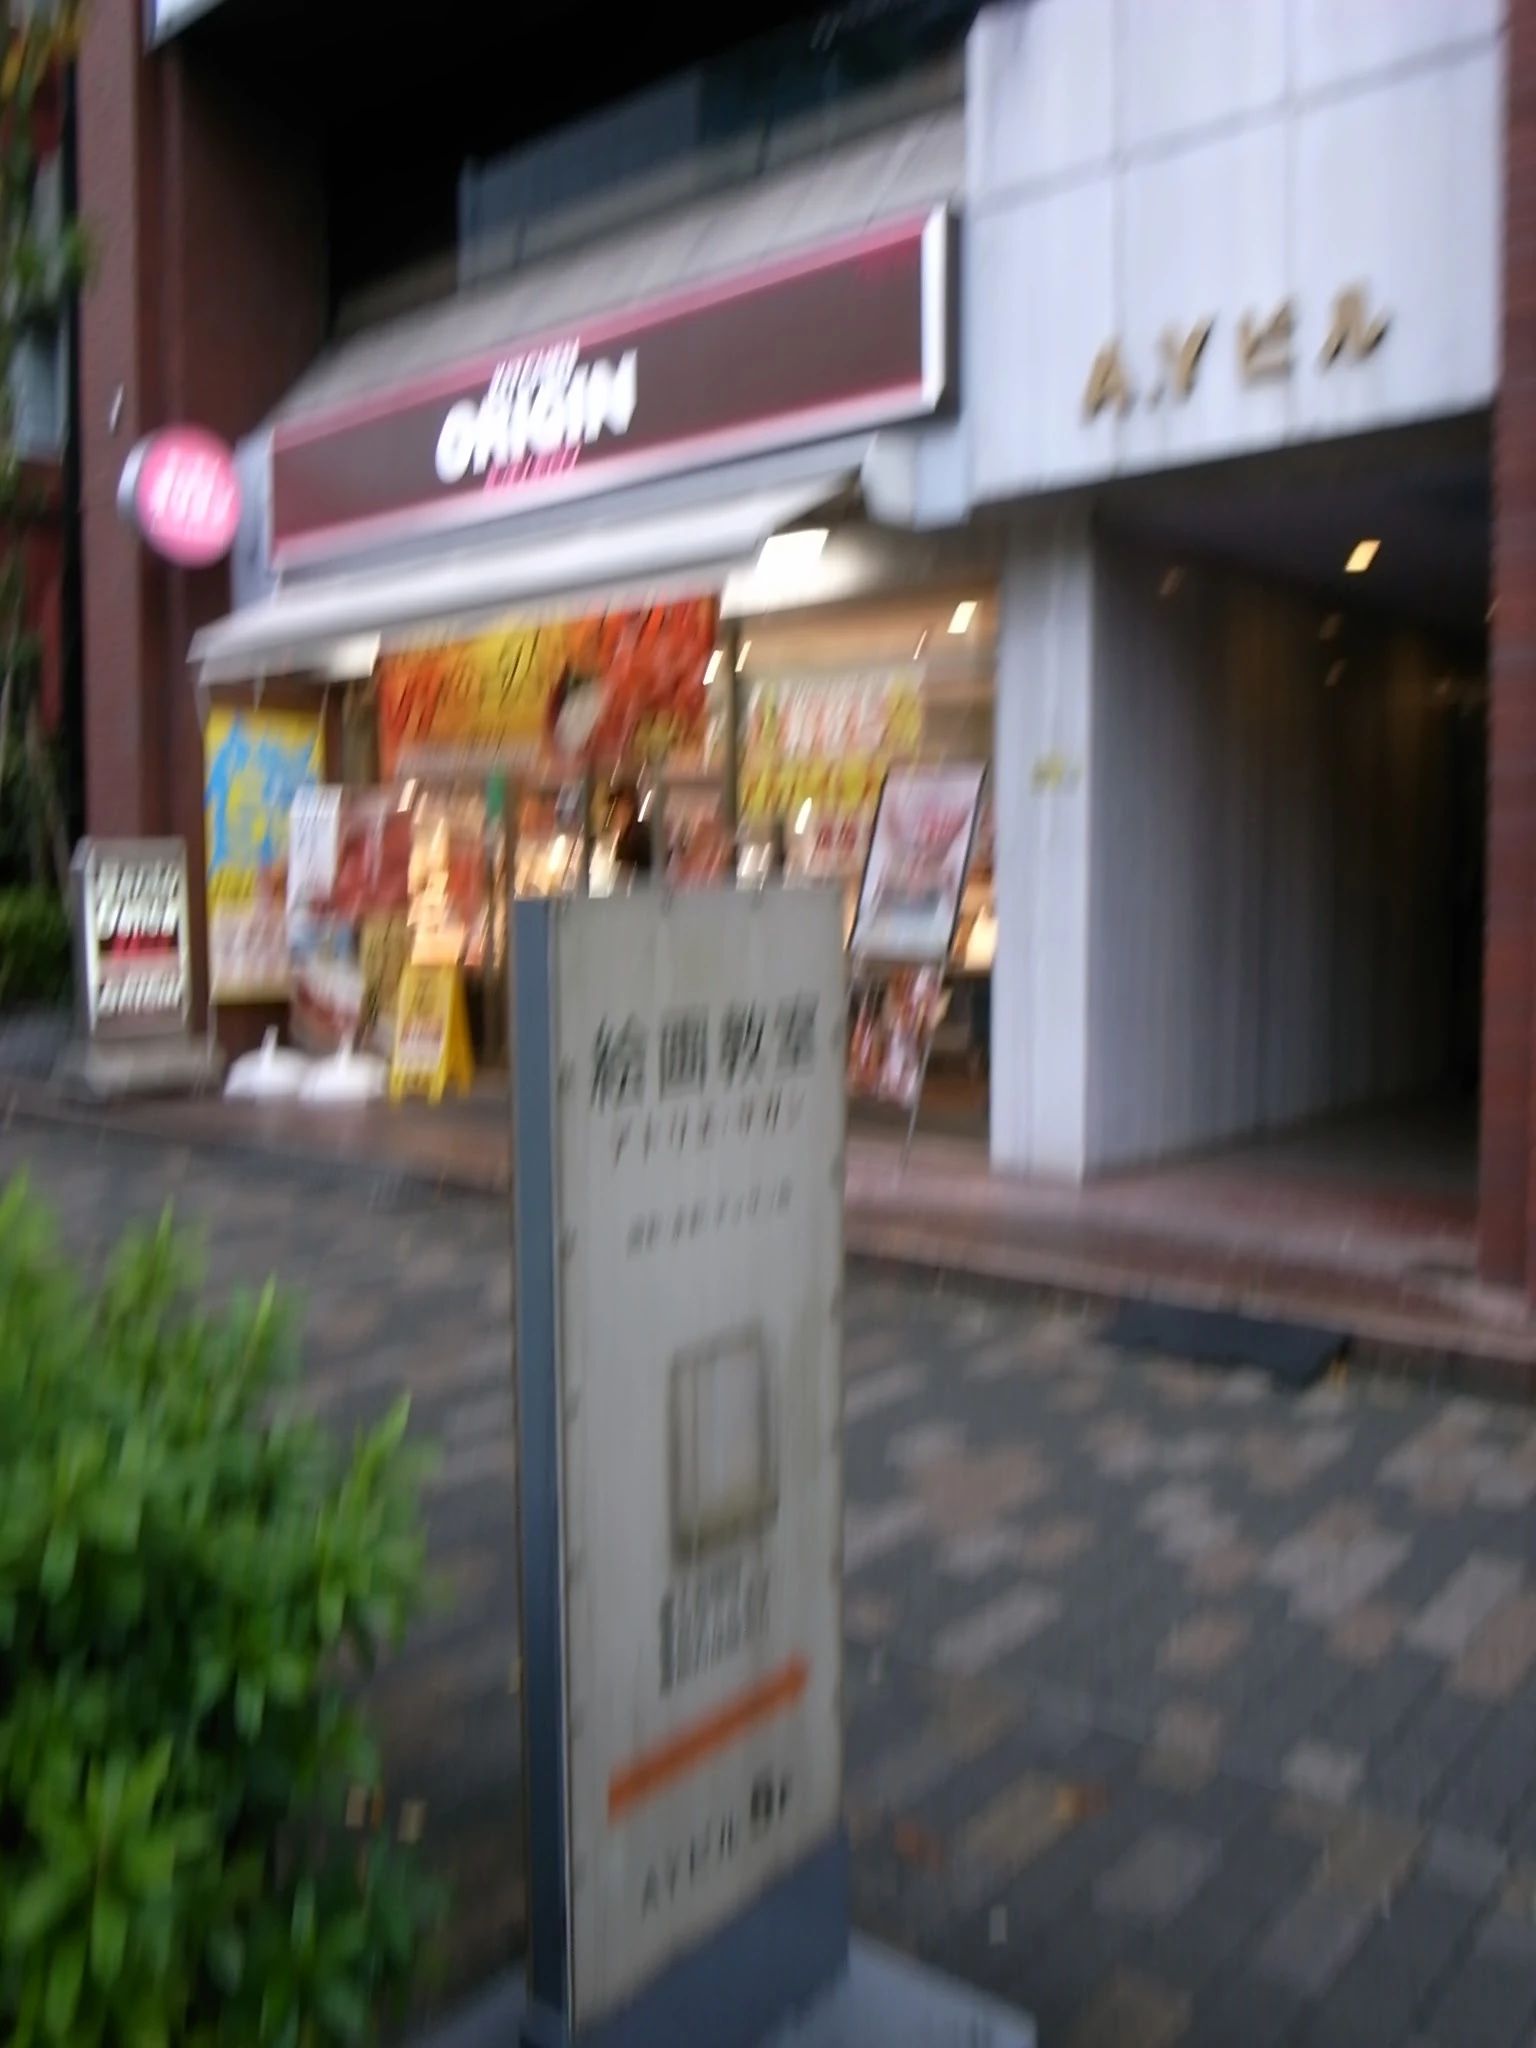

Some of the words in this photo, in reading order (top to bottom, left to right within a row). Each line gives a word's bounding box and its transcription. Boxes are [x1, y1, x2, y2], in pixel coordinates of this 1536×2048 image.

[434, 348, 639, 486] ORIGIN
[588, 991, 820, 1113] 絵画教室
